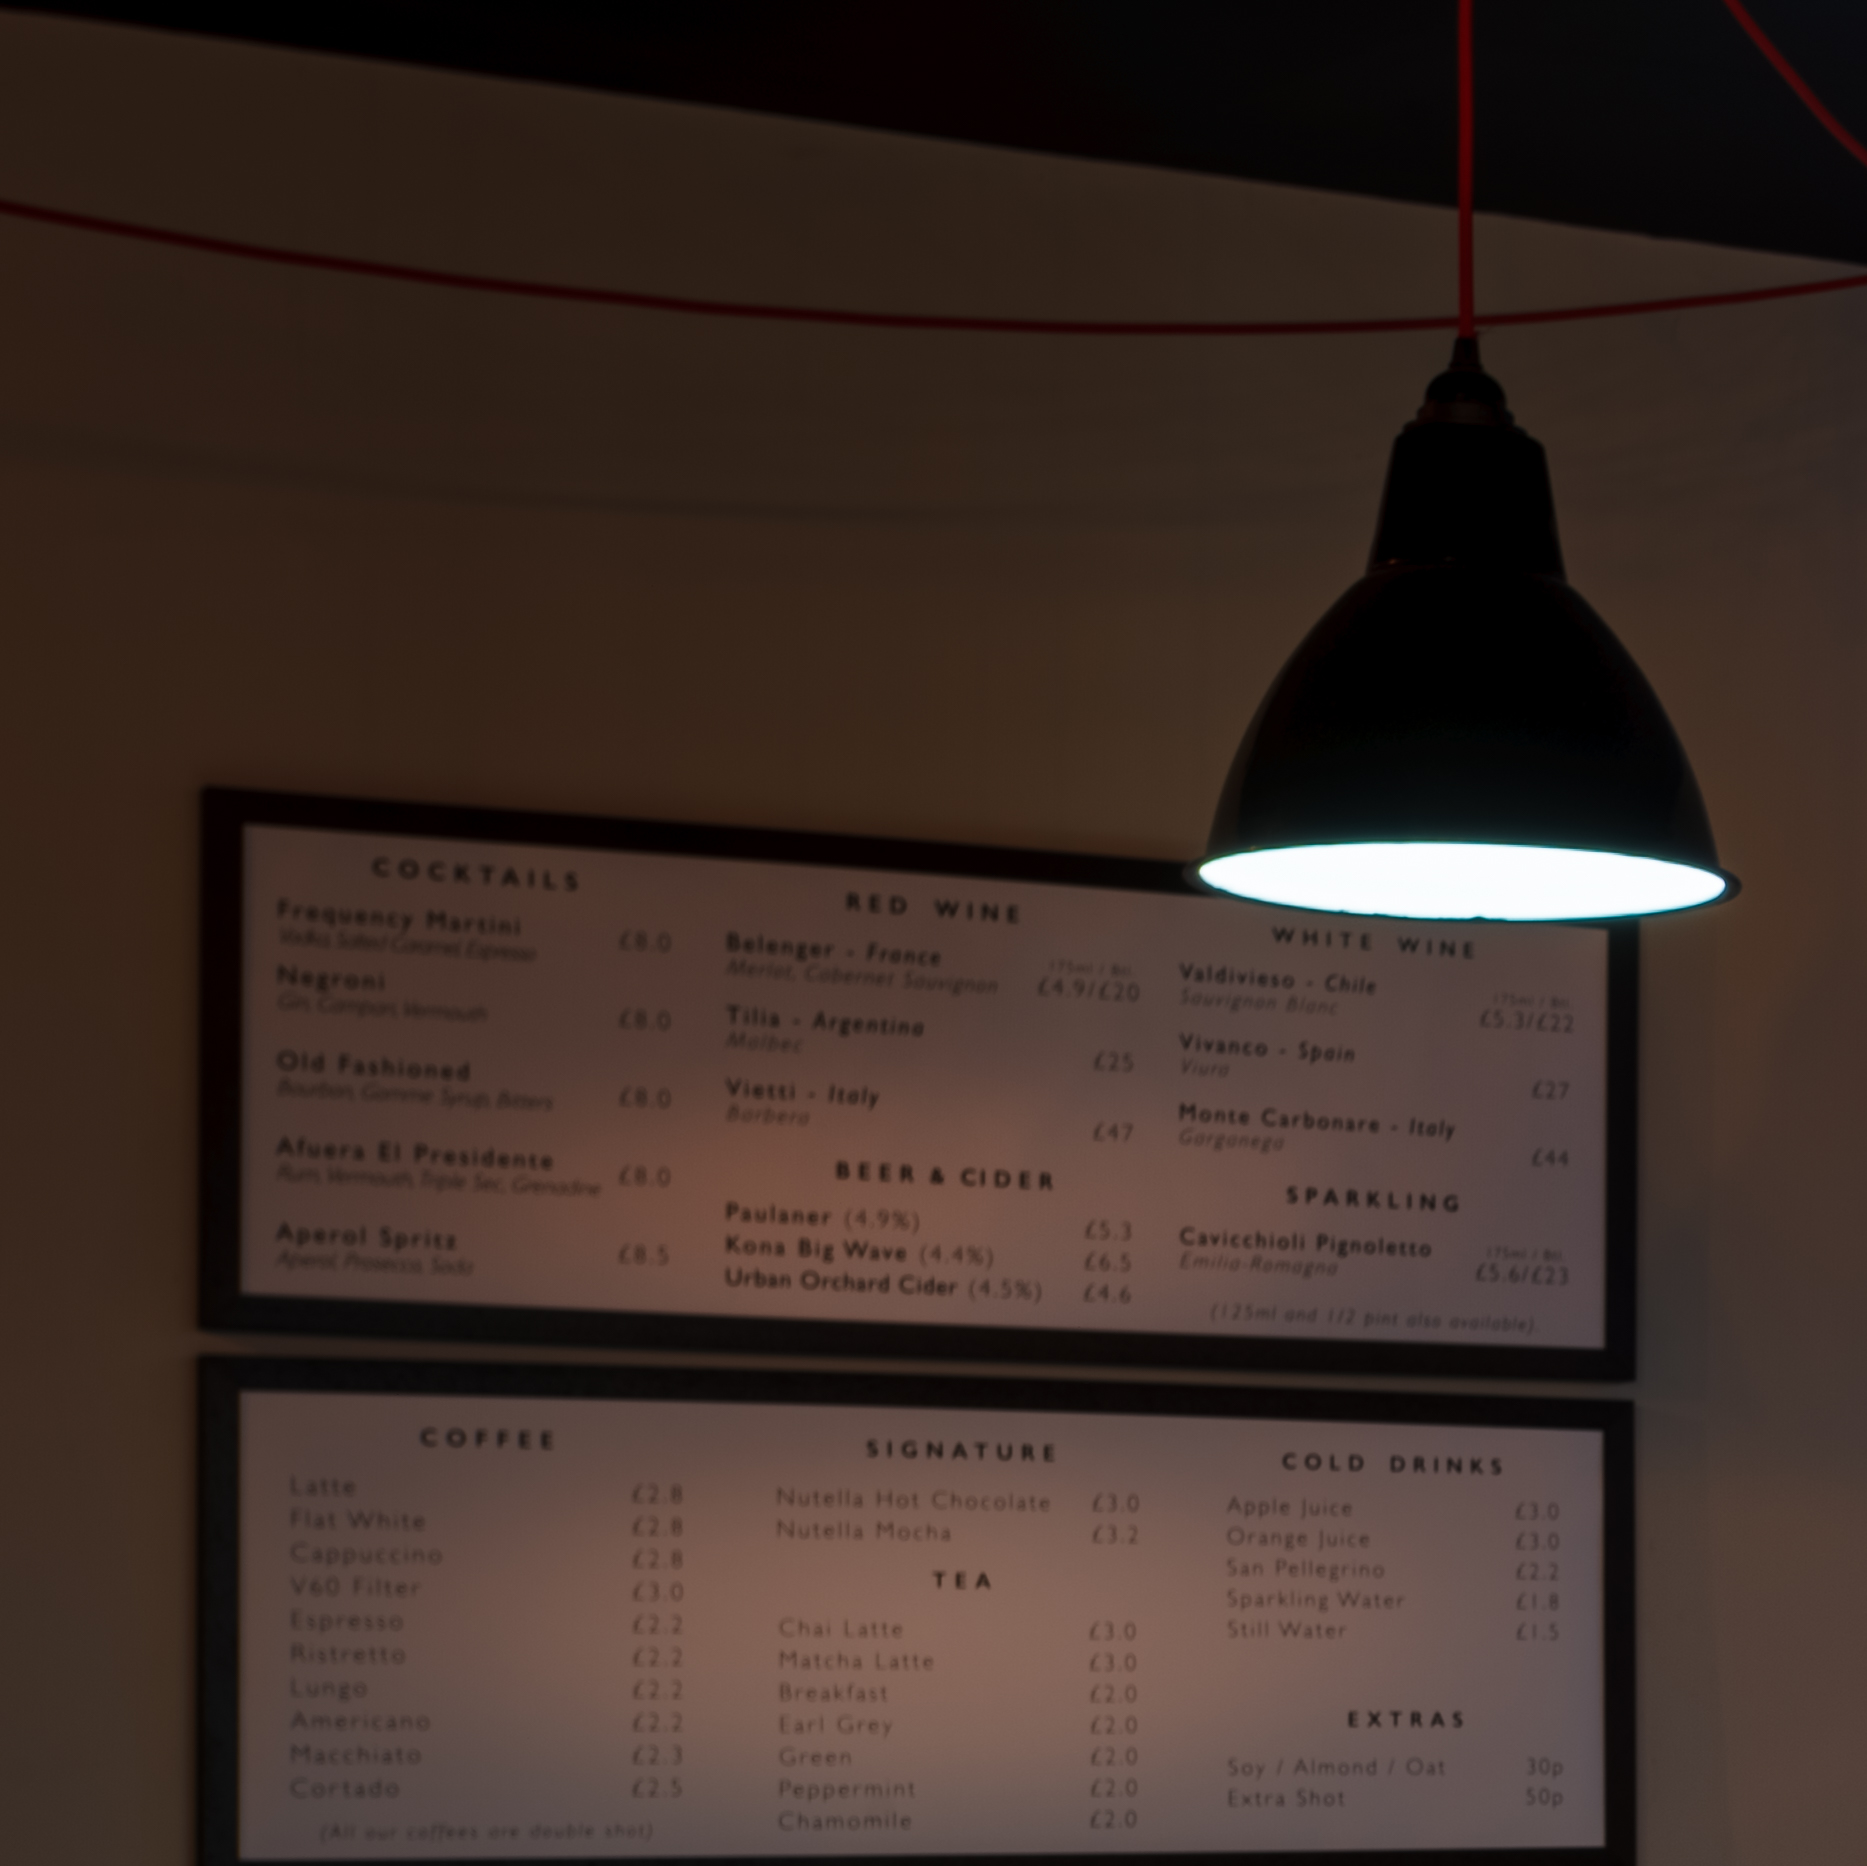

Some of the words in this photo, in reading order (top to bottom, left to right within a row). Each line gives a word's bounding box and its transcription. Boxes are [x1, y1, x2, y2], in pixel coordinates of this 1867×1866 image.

[371, 856, 578, 892] COCKTAILS
[276, 898, 413, 934] Frequency
[426, 910, 521, 934] Martini
[845, 892, 907, 916] RED
[934, 900, 1018, 924] WINE
[1272, 925, 1376, 951] WHITE
[1398, 935, 1474, 959] WINE
[867, 942, 941, 967] France
[276, 964, 384, 994] Negroni
[1324, 973, 1376, 995] Chile
[813, 1011, 924, 1037] Argentina
[1179, 1033, 1268, 1057] Vivanco
[1298, 1041, 1355, 1063] Spain
[276, 1049, 325, 1073] Old
[338, 1053, 470, 1081] Fashioned
[828, 1085, 879, 1109] Italy
[1179, 1103, 1249, 1125] Monte
[1409, 1118, 1455, 1141] Italy
[276, 1137, 365, 1161] Afuera
[377, 1141, 401, 1163] El
[414, 1143, 553, 1171] Presidente
[835, 1160, 914, 1183] BEER
[929, 1166, 945, 1185] &
[960, 1167, 1053, 1190] CIDER
[1286, 1185, 1459, 1213] SPARKLING
[725, 1202, 830, 1225] Paulaner
[276, 1222, 367, 1247] Aperol
[380, 1226, 456, 1251] Spritz
[725, 1235, 786, 1257] Kona
[798, 1237, 834, 1264] Big
[843, 1241, 906, 1262] Wave
[724, 1268, 791, 1288] Urban
[799, 1270, 890, 1294] Orchard
[898, 1274, 957, 1296] Cider
[419, 1427, 552, 1450] COFFEE
[866, 1439, 1054, 1463] SIGNATURE
[1281, 1452, 1365, 1472] COLD
[1390, 1455, 1502, 1476] DRINKS
[290, 1477, 355, 1496] Latte
[776, 1487, 864, 1508] Nutella
[876, 1491, 918, 1509] Hot
[931, 1490, 1050, 1512] Chocolate
[1227, 1496, 1290, 1517] Apple
[1301, 1499, 1352, 1519] Juice
[289, 1508, 335, 1530] Flat
[348, 1511, 425, 1531] White
[776, 1519, 864, 1539] Nutella
[876, 1521, 951, 1542] Mocha
[1226, 1527, 1308, 1551] Orange
[1318, 1531, 1370, 1550] Juice
[289, 1542, 442, 1567] Cappuccino
[933, 1570, 991, 1590] TEA
[1227, 1558, 1264, 1577] San
[1275, 1559, 1385, 1582] Pellegrino
[290, 1577, 340, 1597] V60
[353, 1577, 419, 1598] Filter
[1227, 1589, 1328, 1613] Sparkling
[1337, 1591, 1403, 1608] Water
[290, 1609, 404, 1633] Espresso
[778, 1619, 830, 1637] Chai
[843, 1620, 902, 1638] Latte
[1227, 1620, 1269, 1638] Still
[1279, 1621, 1345, 1639] Water
[290, 1643, 406, 1664] Ristretto
[778, 1651, 862, 1670] Matcha
[875, 1653, 934, 1670] Latte
[290, 1679, 367, 1703] Lungo
[778, 1683, 887, 1702] Breakfast
[291, 1711, 430, 1731] Americano
[778, 1715, 823, 1734] Earl
[836, 1715, 892, 1736] Grey
[1347, 1710, 1463, 1729] EXTRAS
[290, 1744, 421, 1765] Macchiato
[778, 1747, 851, 1766] Green
[1227, 1757, 1265, 1779] Soy
[1294, 1758, 1377, 1776] Almond
[1405, 1757, 1445, 1776] Oat
[1528, 1757, 1563, 1778] 30p
[289, 1777, 399, 1799] Cortado
[778, 1779, 914, 1801] Peppermint
[1227, 1788, 1285, 1807] Extra
[1296, 1788, 1344, 1807] Shot
[1526, 1786, 1564, 1808] 50p
[777, 1811, 911, 1830] Chamomile
